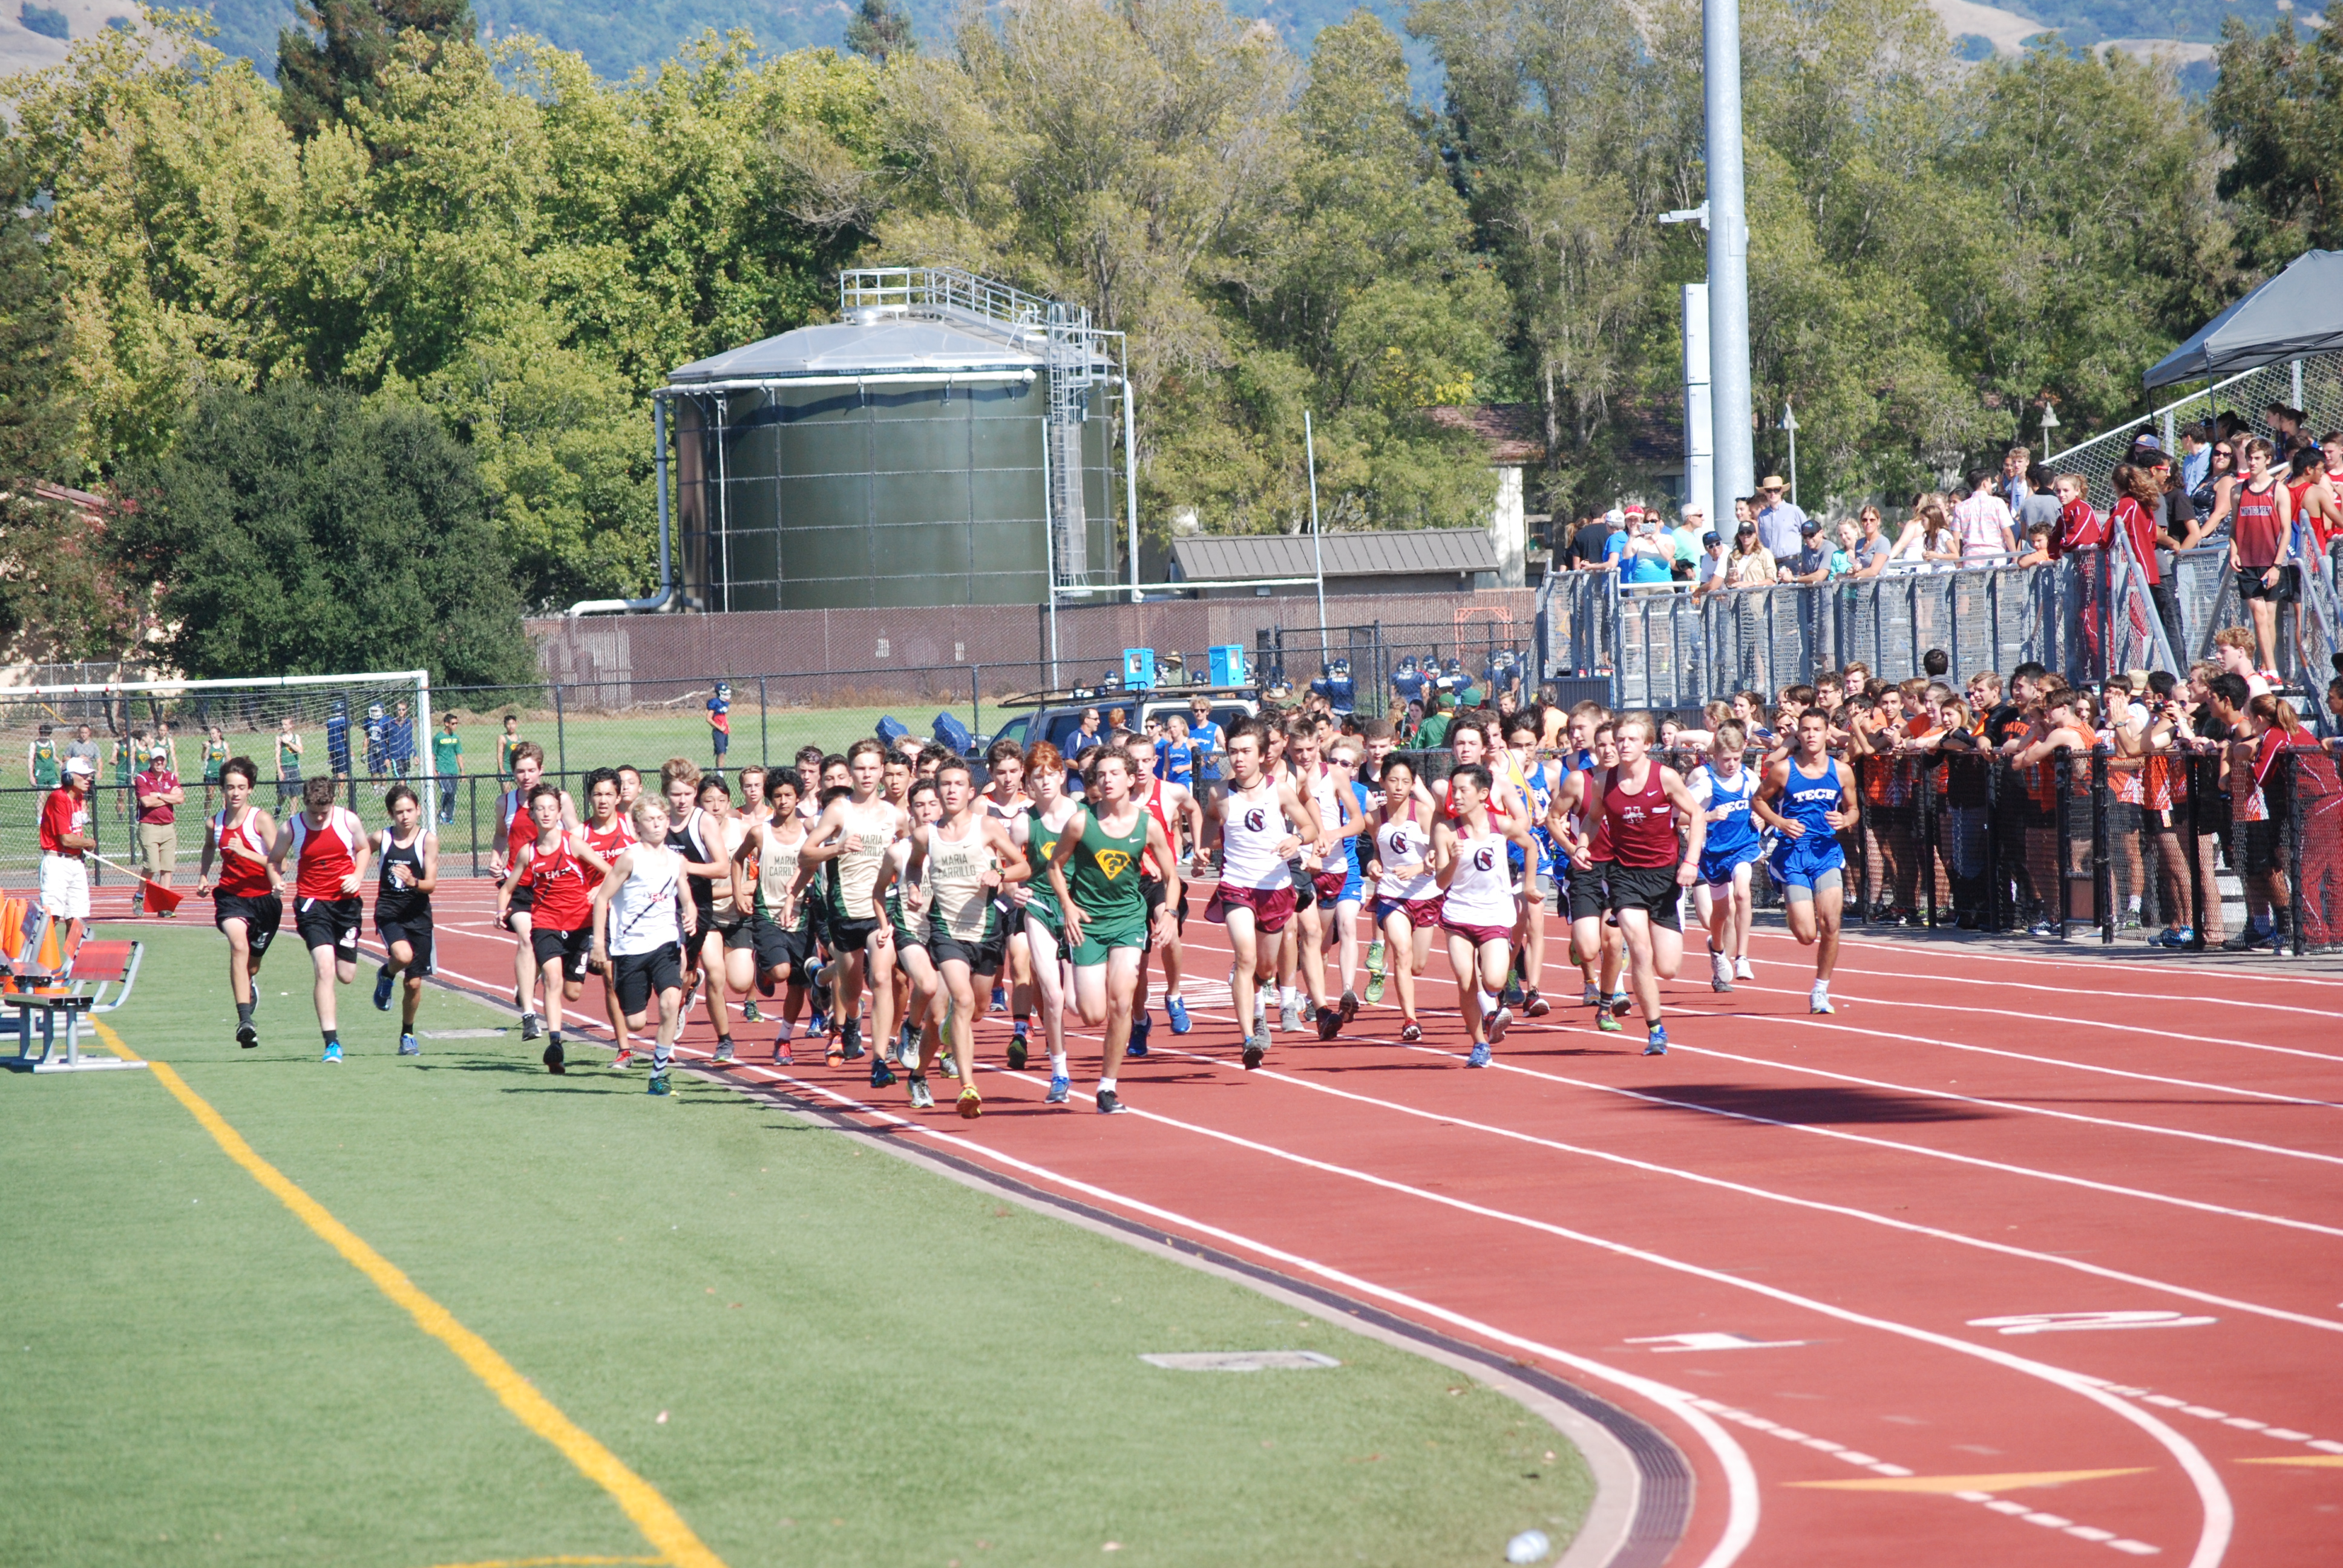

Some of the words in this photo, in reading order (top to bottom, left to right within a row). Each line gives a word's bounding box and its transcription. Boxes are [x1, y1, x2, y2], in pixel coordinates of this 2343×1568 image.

[1793, 789, 1837, 802] TECH
[775, 855, 796, 865] MARIA
[941, 853, 968, 866] MARIA
